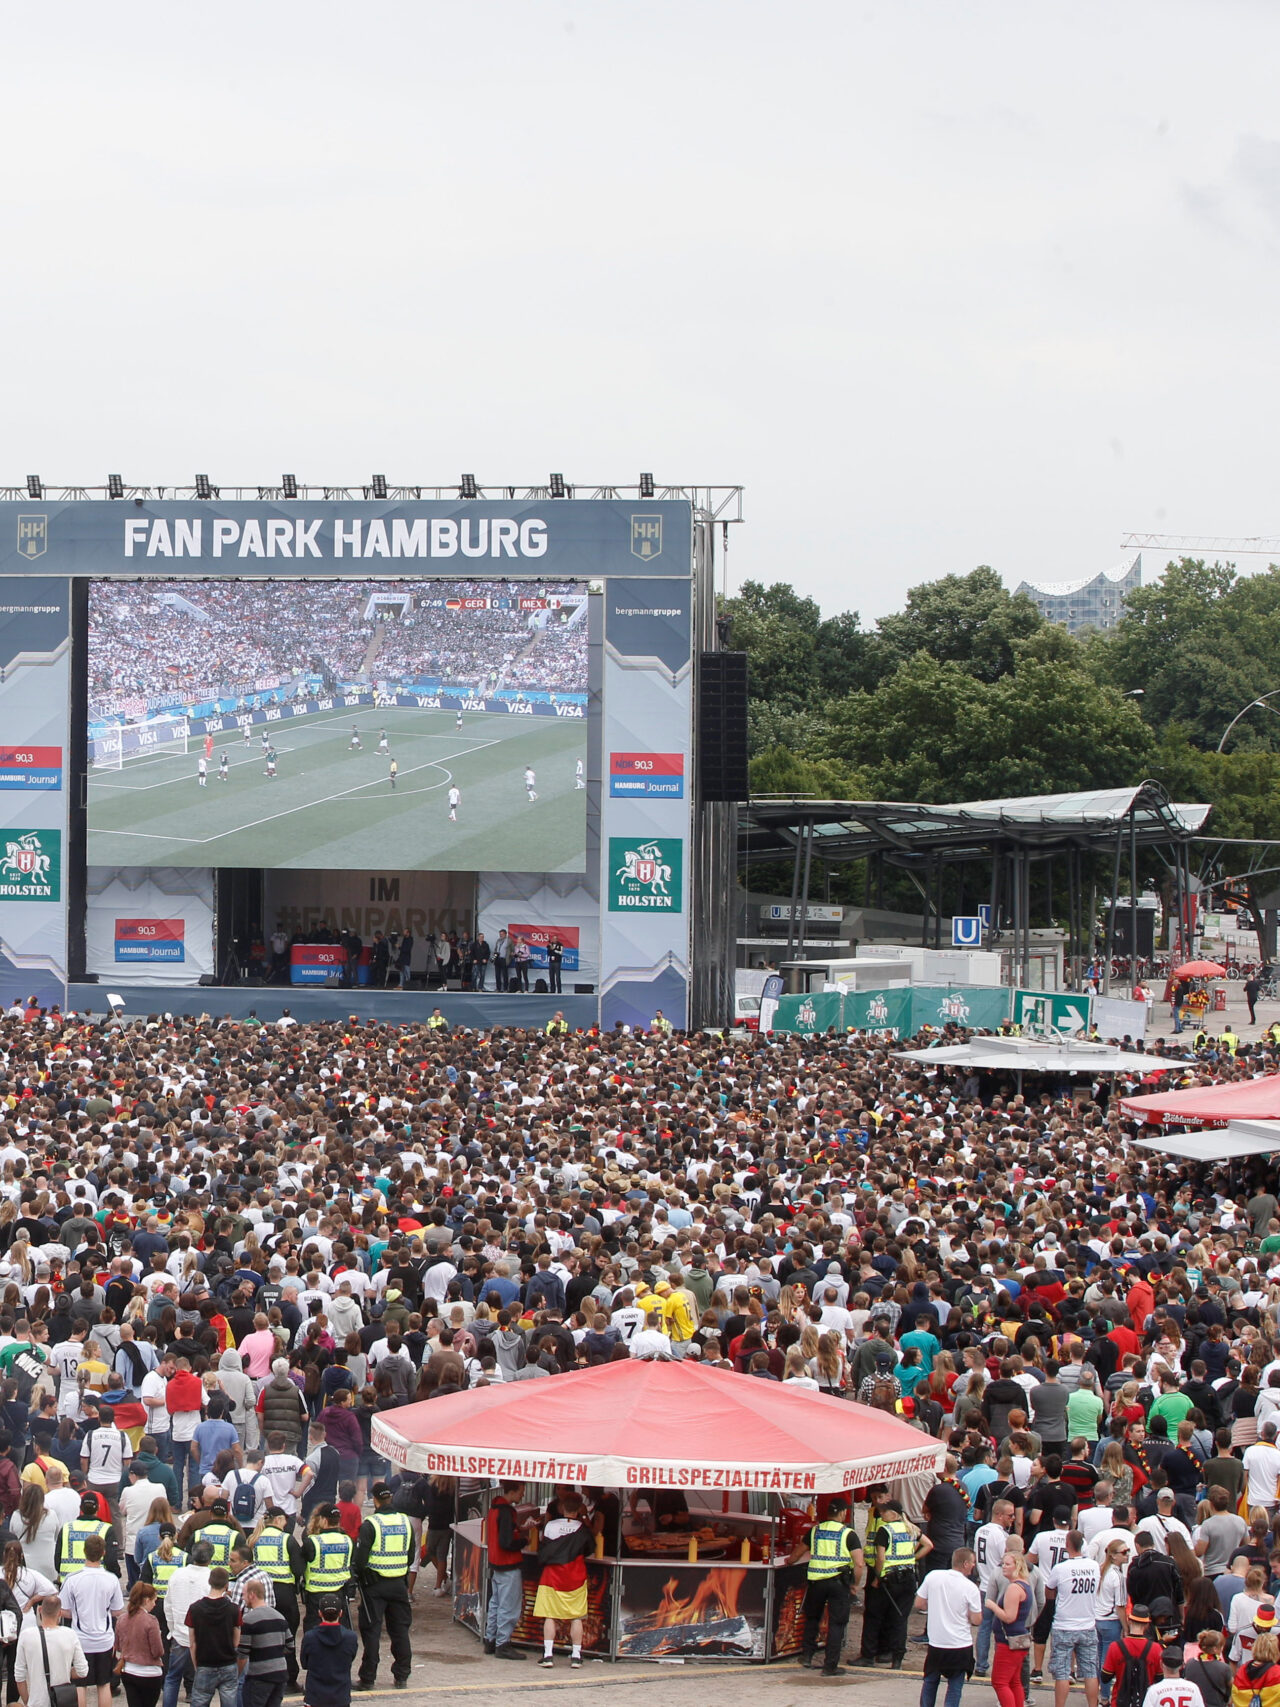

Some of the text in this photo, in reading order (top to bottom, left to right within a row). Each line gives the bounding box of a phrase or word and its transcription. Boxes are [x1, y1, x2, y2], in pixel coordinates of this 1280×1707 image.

[124, 519, 548, 558] FAN PARK HAMBURG
[421, 599, 442, 608] 67:49
[465, 600, 484, 608] GER
[492, 600, 499, 608] 0
[522, 600, 542, 608] MEX
[616, 607, 682, 618] bergmanngruppe
[318, 700, 332, 710] VISA
[344, 696, 359, 706] VISA
[416, 696, 441, 708] VISA
[460, 699, 486, 712] VISA
[264, 708, 281, 720] VISA
[292, 704, 308, 714] VISA
[506, 702, 533, 714] VISA
[554, 705, 583, 718] VISA
[204, 719, 224, 732] VISA
[236, 714, 254, 726] VISA
[172, 725, 190, 739] VISA
[138, 732, 158, 746] VISA
[16, 754, 33, 764] 90,3
[634, 761, 653, 770] 90,3
[28, 775, 58, 784] Journal
[647, 782, 679, 792] Journal
[20, 854, 32, 870] H
[640, 864, 652, 879] H
[0, 884, 51, 896] HOLSTEN
[370, 878, 400, 901] IM
[618, 896, 672, 907] HOLSTEN
[772, 907, 780, 917] U
[138, 926, 156, 936] 90,3
[532, 932, 550, 942] 90,3
[957, 920, 976, 942] U
[150, 948, 180, 956] Journal
[318, 954, 334, 962] 90,3
[624, 1322, 636, 1339] 7
[102, 1444, 112, 1466] 7
[427, 1453, 588, 1481] GRILLSPEZIALITÄTEN
[843, 1454, 936, 1487] GRILLSPEZIALITÄTEN
[627, 1466, 816, 1490] GRILLSPEZIALITÄTEN
[382, 1526, 406, 1534] POLIZEI
[816, 1530, 840, 1540] POLIZEI
[258, 1537, 282, 1545] OLIZEI
[322, 1544, 348, 1552] POLIZEI
[978, 1537, 986, 1563] 8
[1072, 1578, 1096, 1594] 2806
